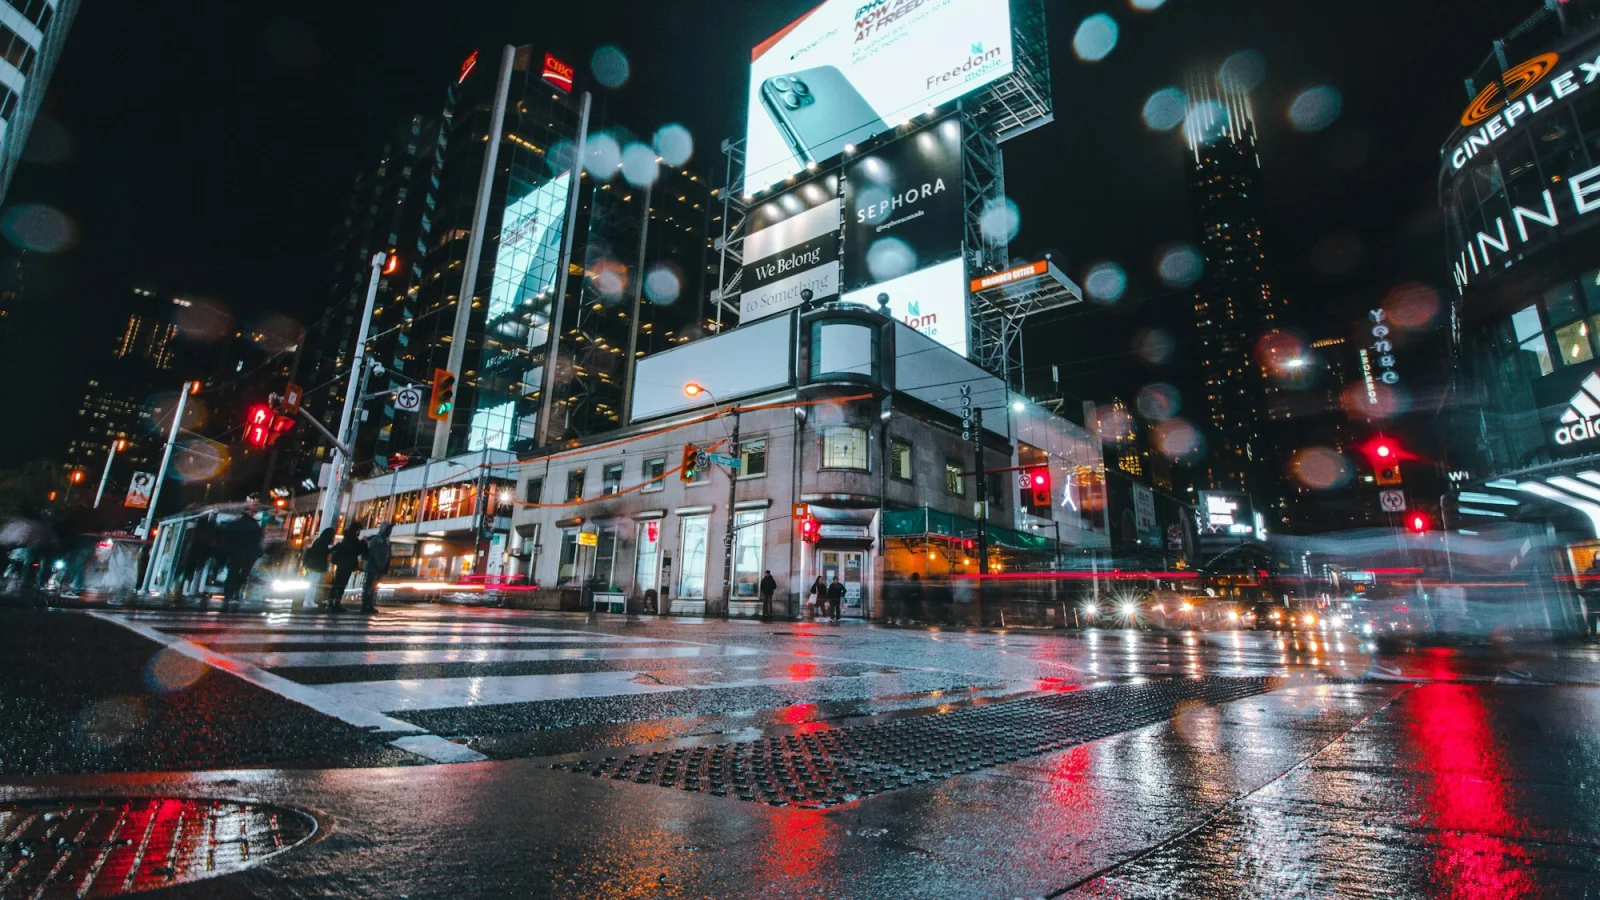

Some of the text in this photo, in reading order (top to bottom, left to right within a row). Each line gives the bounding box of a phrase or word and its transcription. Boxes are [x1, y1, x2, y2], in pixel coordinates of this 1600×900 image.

[853, 0, 926, 44] AT FREED
[854, 2, 891, 32] NOW
[546, 57, 574, 79] CIBC
[926, 46, 1001, 90] Freedom
[964, 59, 1002, 82] mobile
[1451, 55, 1600, 169] CINEPLEX
[857, 178, 946, 224] SEPHORA
[755, 247, 821, 280] We Belong
[1012, 265, 1035, 280] CITIES
[746, 301, 758, 313] to
[1368, 308, 1399, 384] Yonge
[1360, 348, 1378, 404] DOWNTOWN
[960, 385, 971, 441] Yonge
